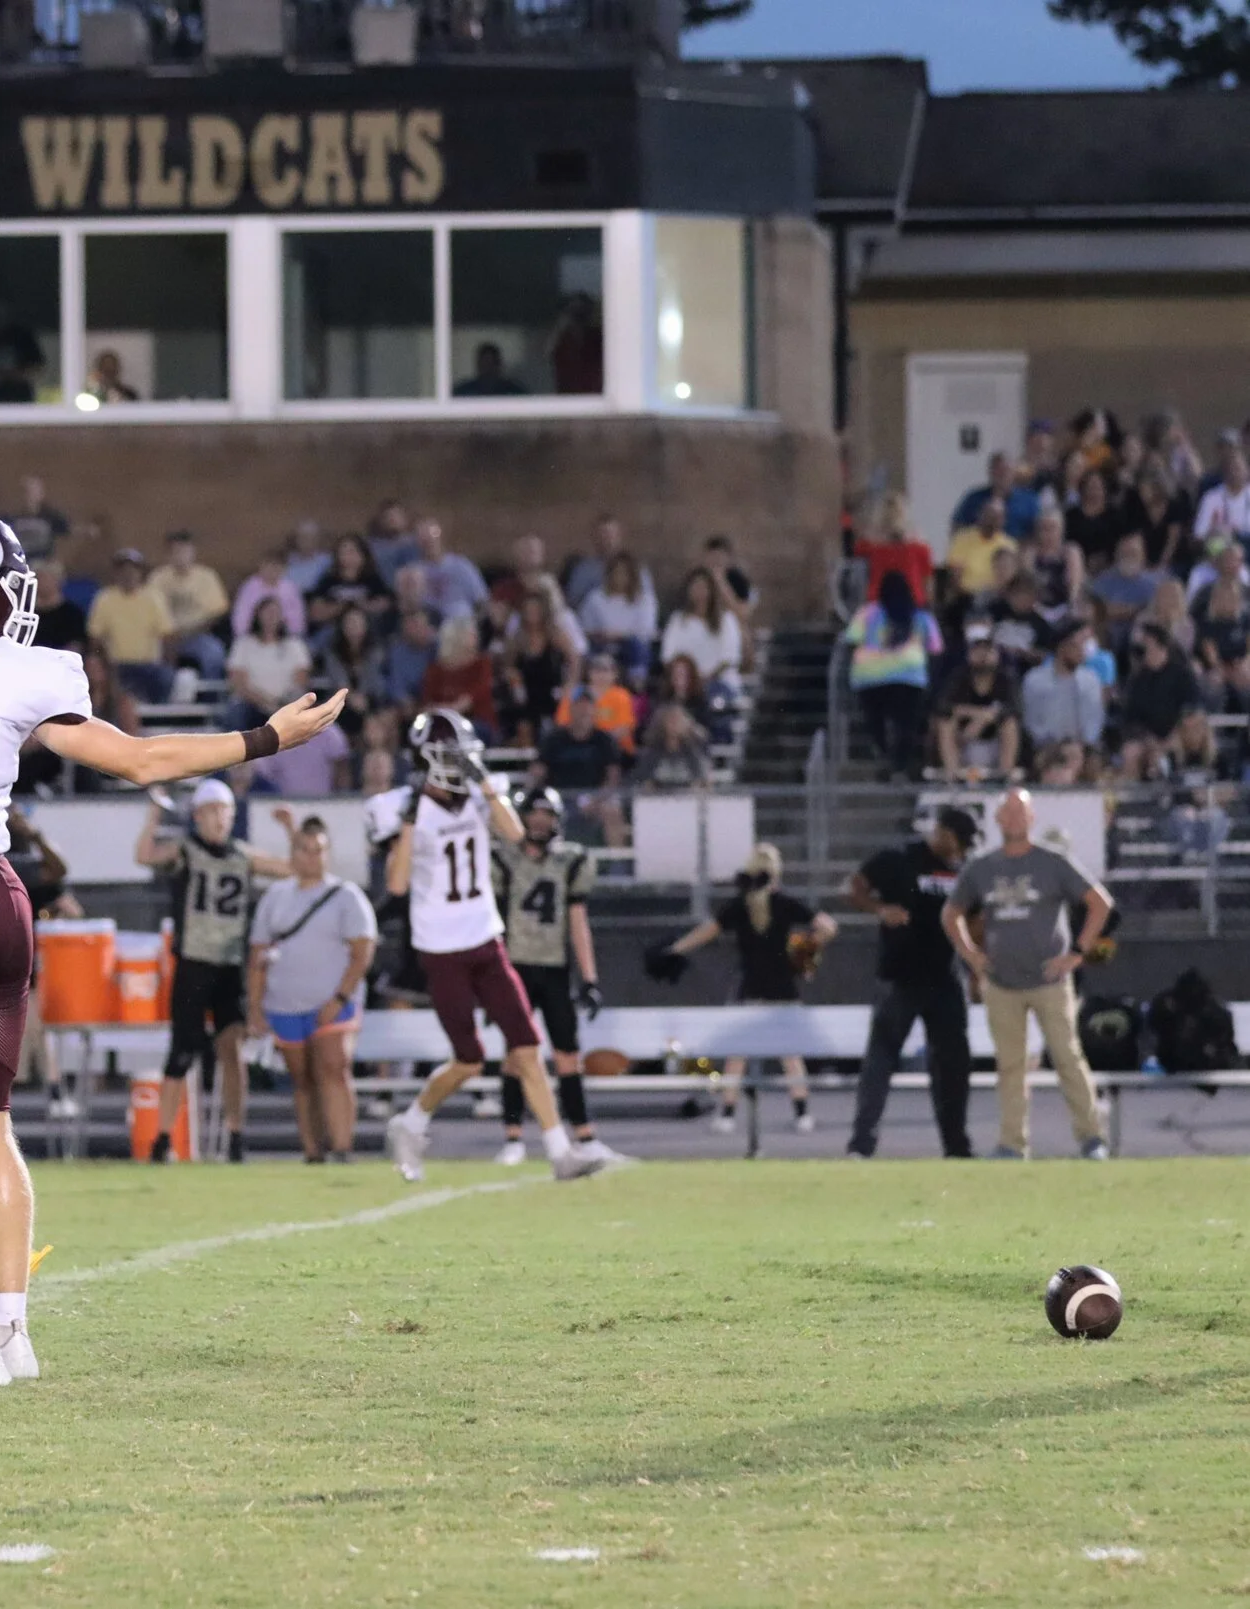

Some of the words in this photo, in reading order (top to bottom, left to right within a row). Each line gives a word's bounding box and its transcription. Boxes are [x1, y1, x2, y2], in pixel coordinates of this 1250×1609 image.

[21, 110, 445, 208] WILDCATS
[195, 869, 243, 916] 12
[444, 837, 482, 903] 11
[521, 880, 556, 924] 4
